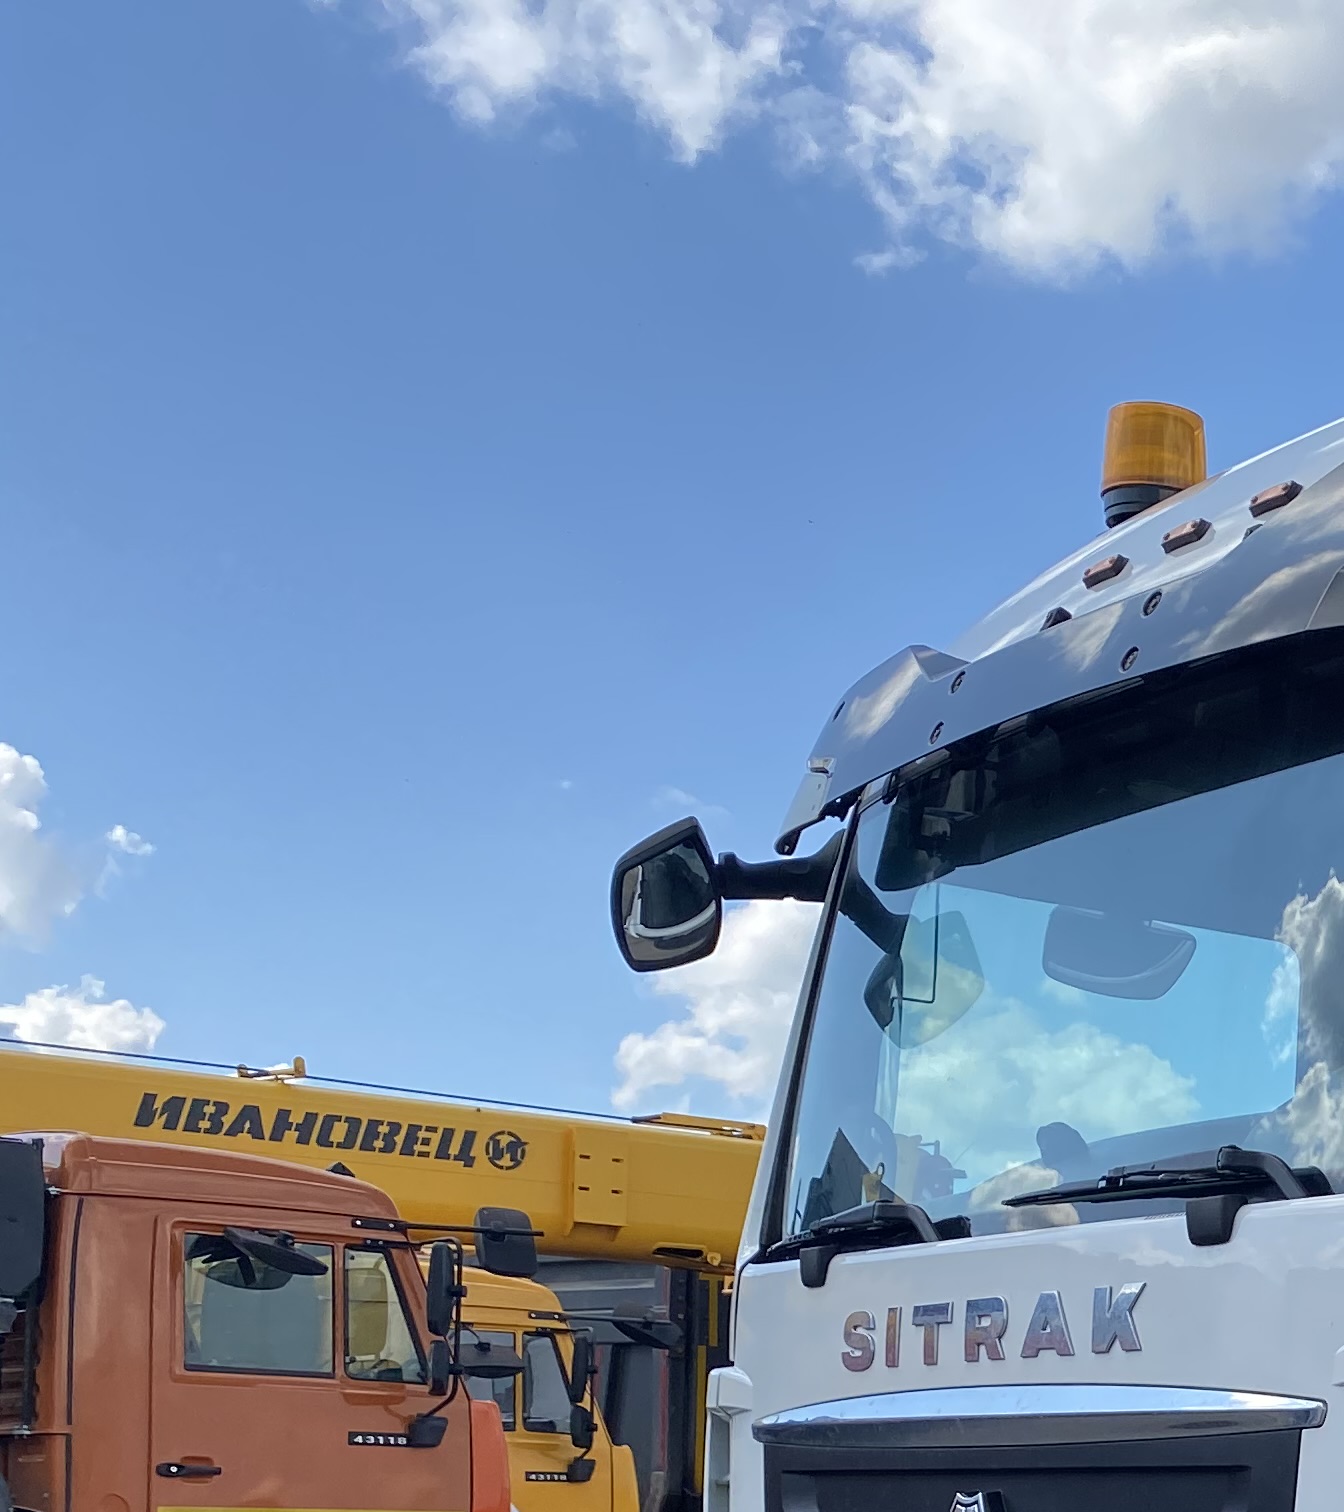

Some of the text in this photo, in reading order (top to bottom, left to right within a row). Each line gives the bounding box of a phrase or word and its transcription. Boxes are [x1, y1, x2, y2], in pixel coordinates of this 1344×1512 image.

[134, 1092, 478, 1168] ИВАНОВЕЦ
[841, 1281, 1147, 1372] SITRAK
[353, 1434, 408, 1446] 43118
